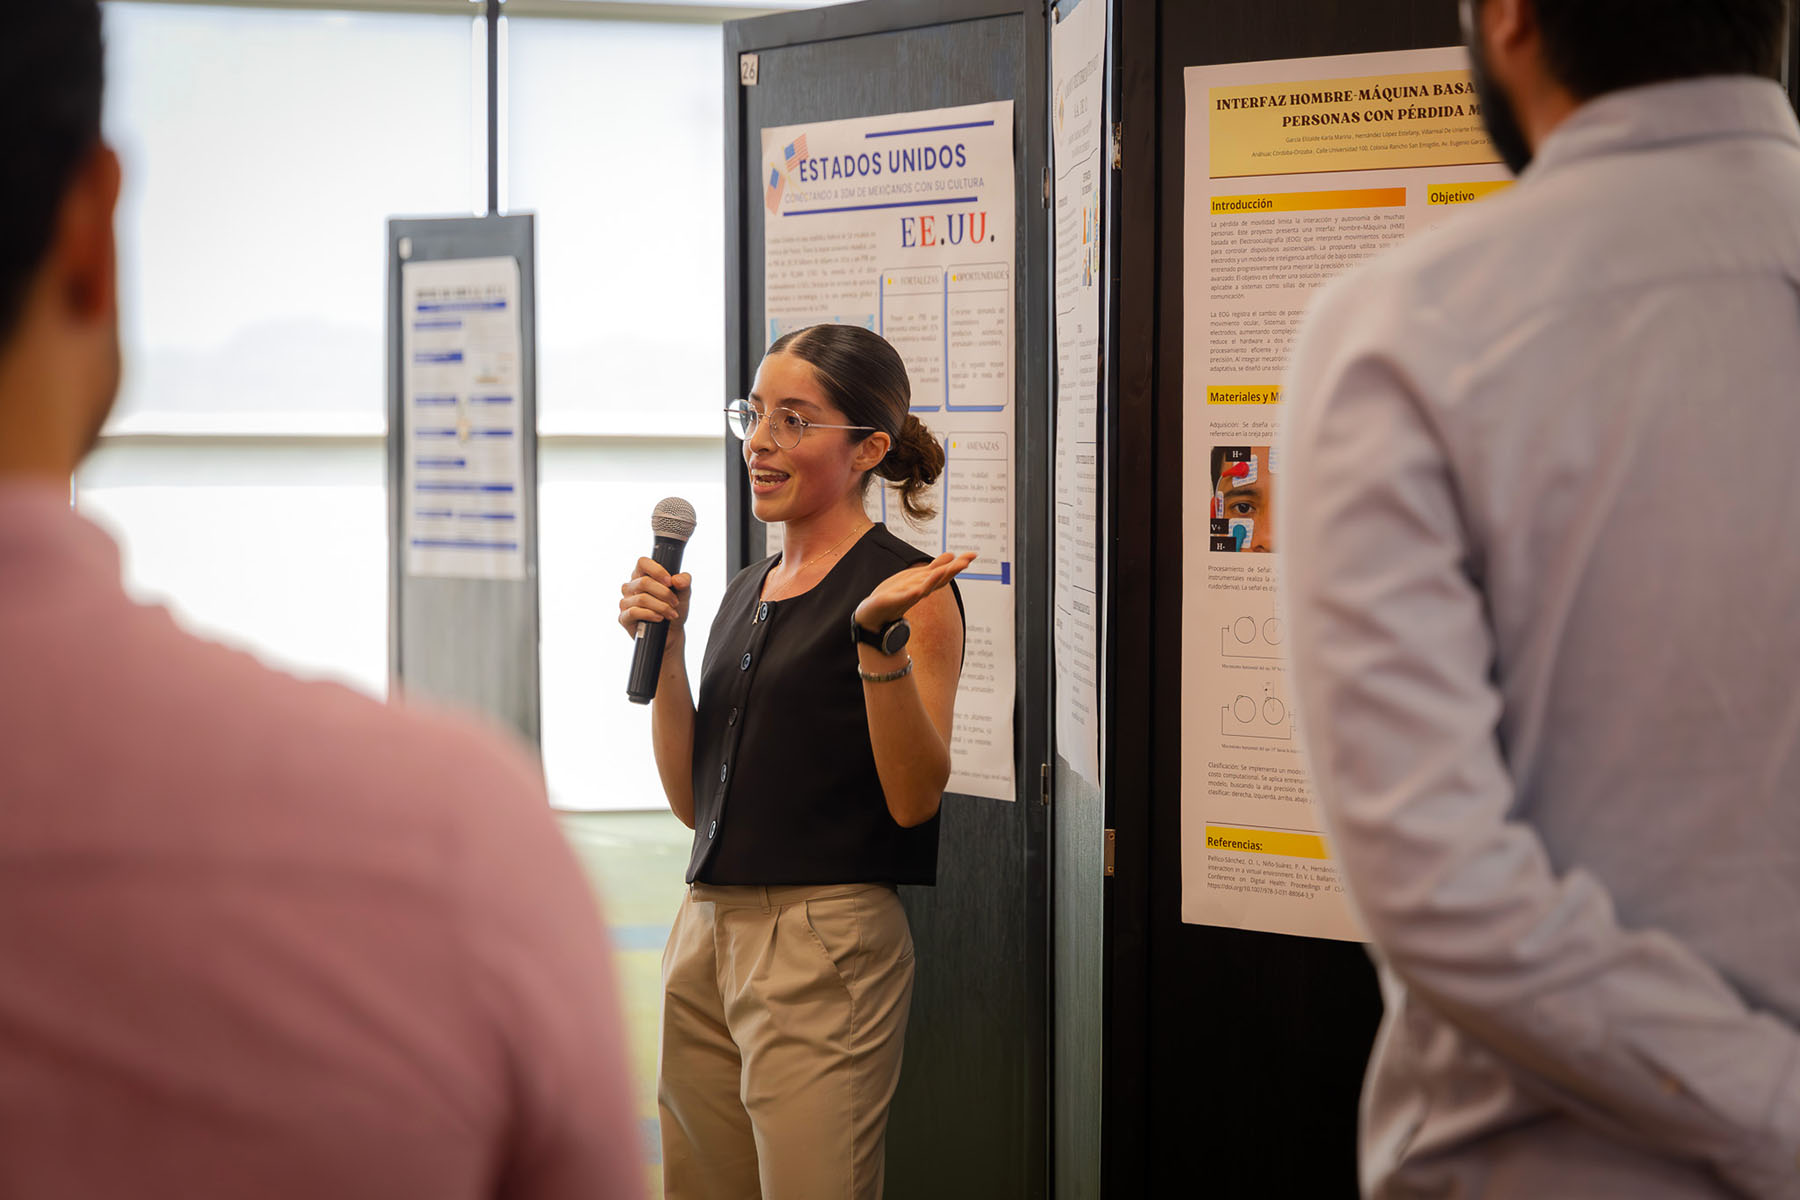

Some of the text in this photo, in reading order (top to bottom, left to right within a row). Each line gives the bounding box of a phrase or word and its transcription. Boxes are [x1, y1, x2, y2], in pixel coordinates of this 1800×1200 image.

[743, 61, 755, 80] 26
[1216, 82, 1480, 111] INTERFAZ HOMBRE-MÁQUINA BASA
[1282, 103, 1481, 128] PERSONAS CON PÉRDIDA M
[799, 143, 967, 183] ESTADOS UNIDOS
[914, 181, 933, 193] CON
[934, 180, 946, 191] SU
[947, 177, 984, 190] CULTURA
[1212, 198, 1273, 211] Introducción
[1430, 191, 1475, 205] Objetivo
[900, 211, 995, 248] EE.UU.
[1220, 220, 1239, 228] pérdida
[1329, 243, 1356, 251] propuesta
[1335, 253, 1346, 261] bajo
[1292, 264, 1313, 272] mejorar
[1320, 262, 1344, 270] precisión
[1210, 391, 1261, 402] Materiales
[1248, 431, 1261, 439] oreja
[1208, 565, 1244, 573] Procesamiento
[1249, 765, 1277, 773] implementa
[1230, 781, 1254, 789] buscando
[1273, 785, 1296, 793] precisión
[1207, 836, 1263, 851] Referencias:
[1207, 872, 1235, 882] Conference
[1250, 877, 1265, 885] Digital
[1290, 882, 1321, 891] Proceedings
